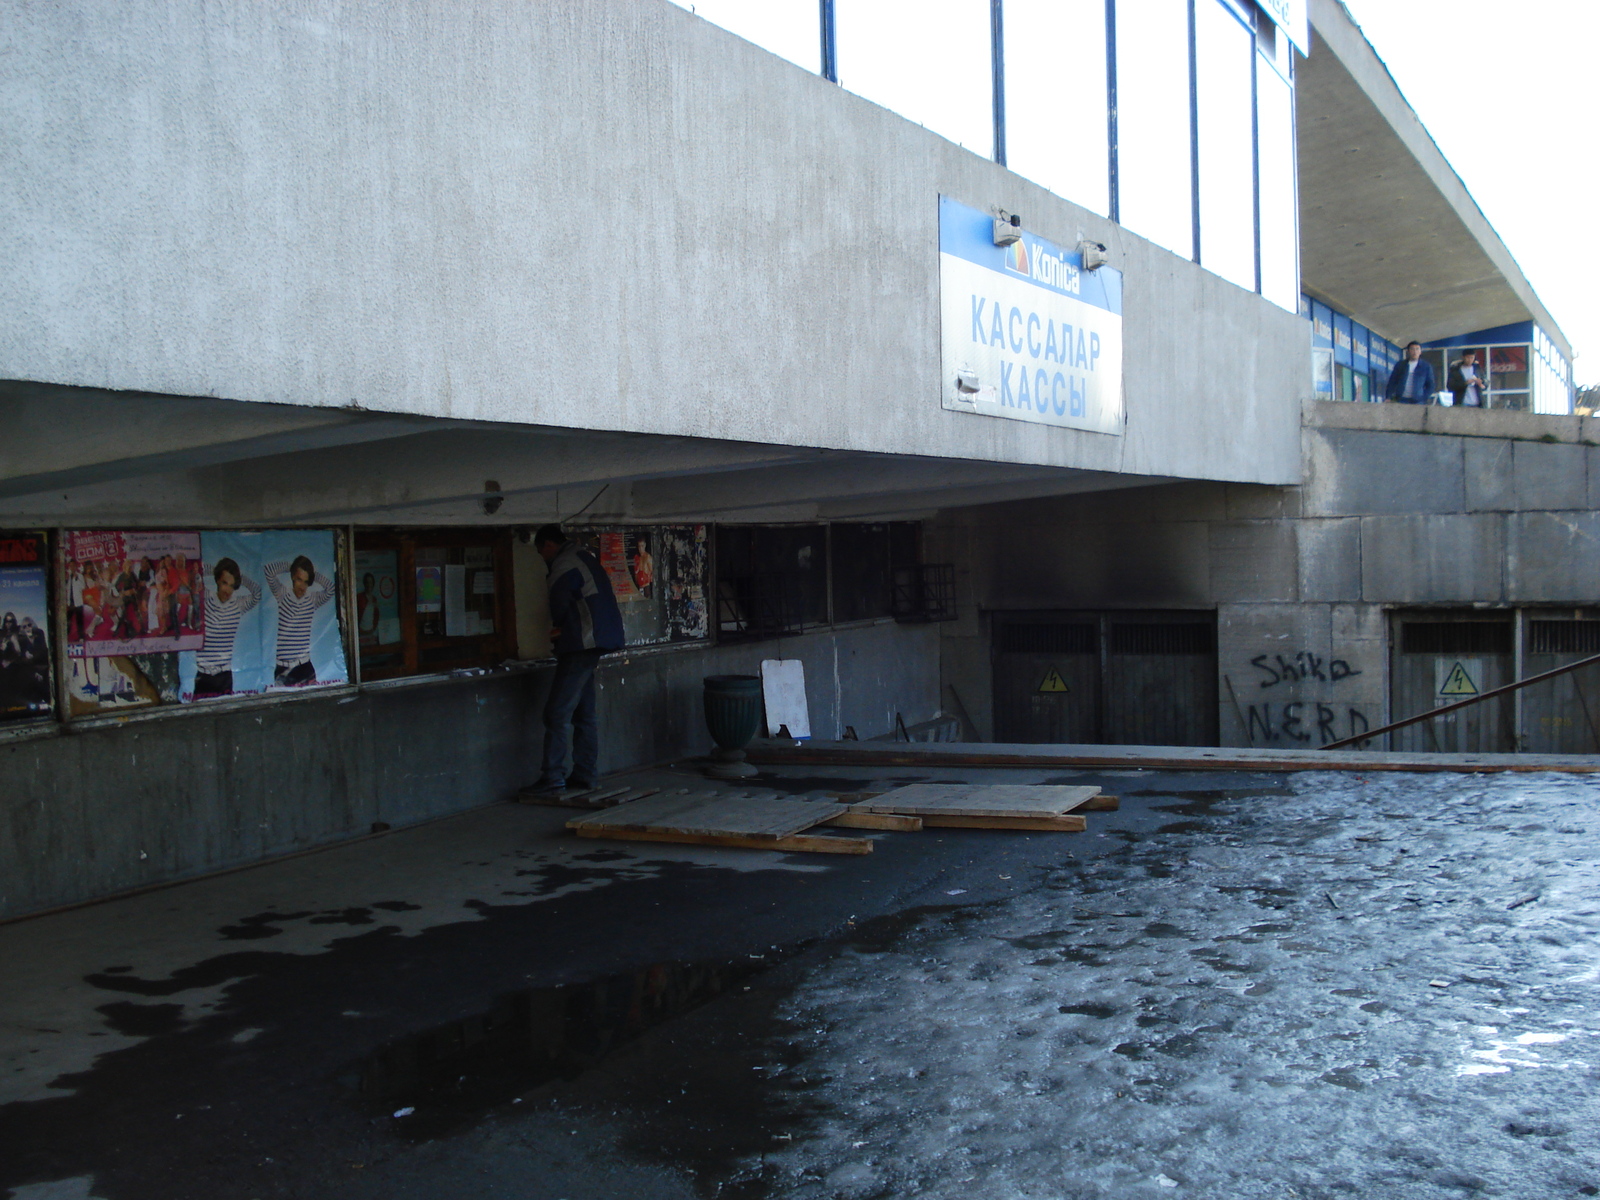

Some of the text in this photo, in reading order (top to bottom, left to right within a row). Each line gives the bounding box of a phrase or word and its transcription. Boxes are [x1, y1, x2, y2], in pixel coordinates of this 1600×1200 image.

[1032, 243, 1081, 295] Konica
[971, 294, 1100, 372] КАССАЛАР
[1000, 360, 1087, 418] КАССЫ
[1251, 651, 1361, 689] Shika
